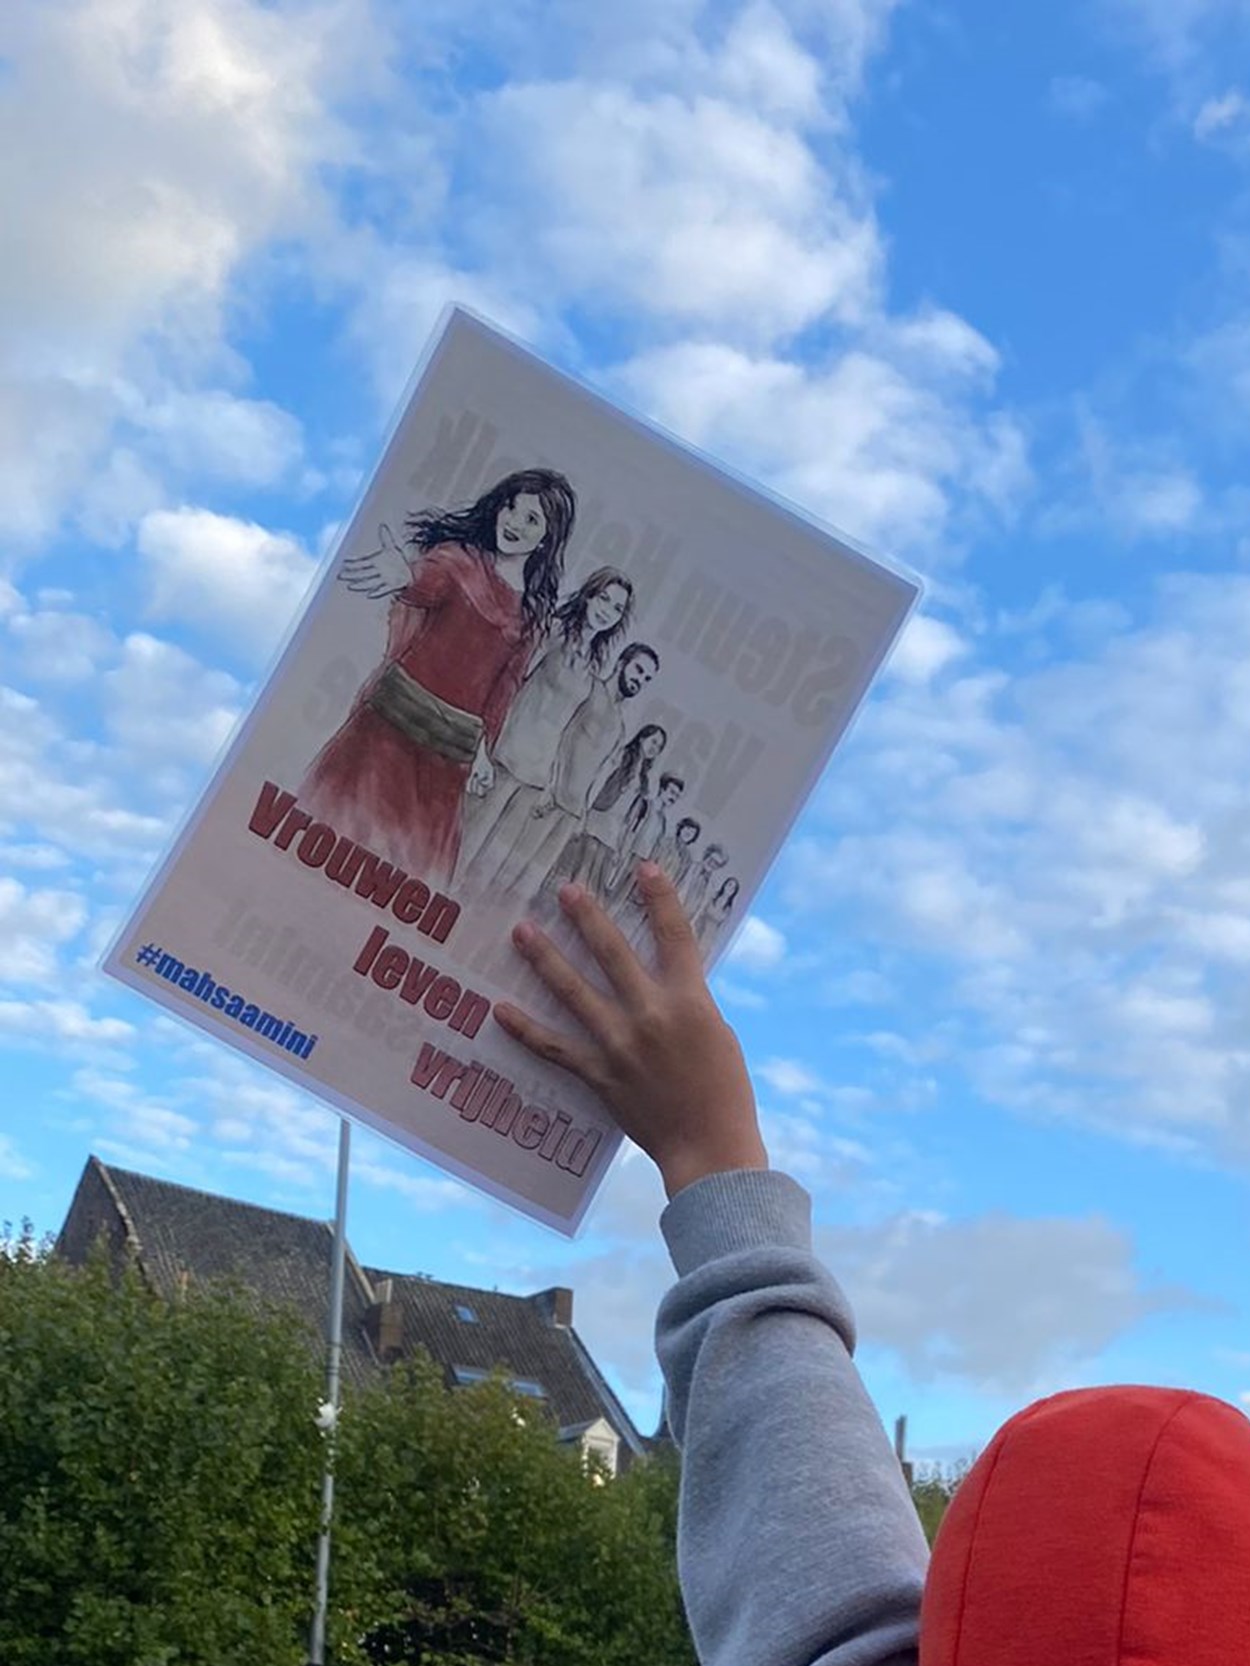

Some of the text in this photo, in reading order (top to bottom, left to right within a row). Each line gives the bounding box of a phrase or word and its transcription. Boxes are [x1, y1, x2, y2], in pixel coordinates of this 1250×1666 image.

[247, 780, 462, 944] Vrouwen
[135, 942, 318, 1061] #mahsaamini
[353, 925, 492, 1039] leven
[411, 1041, 604, 1178] vrijheid
